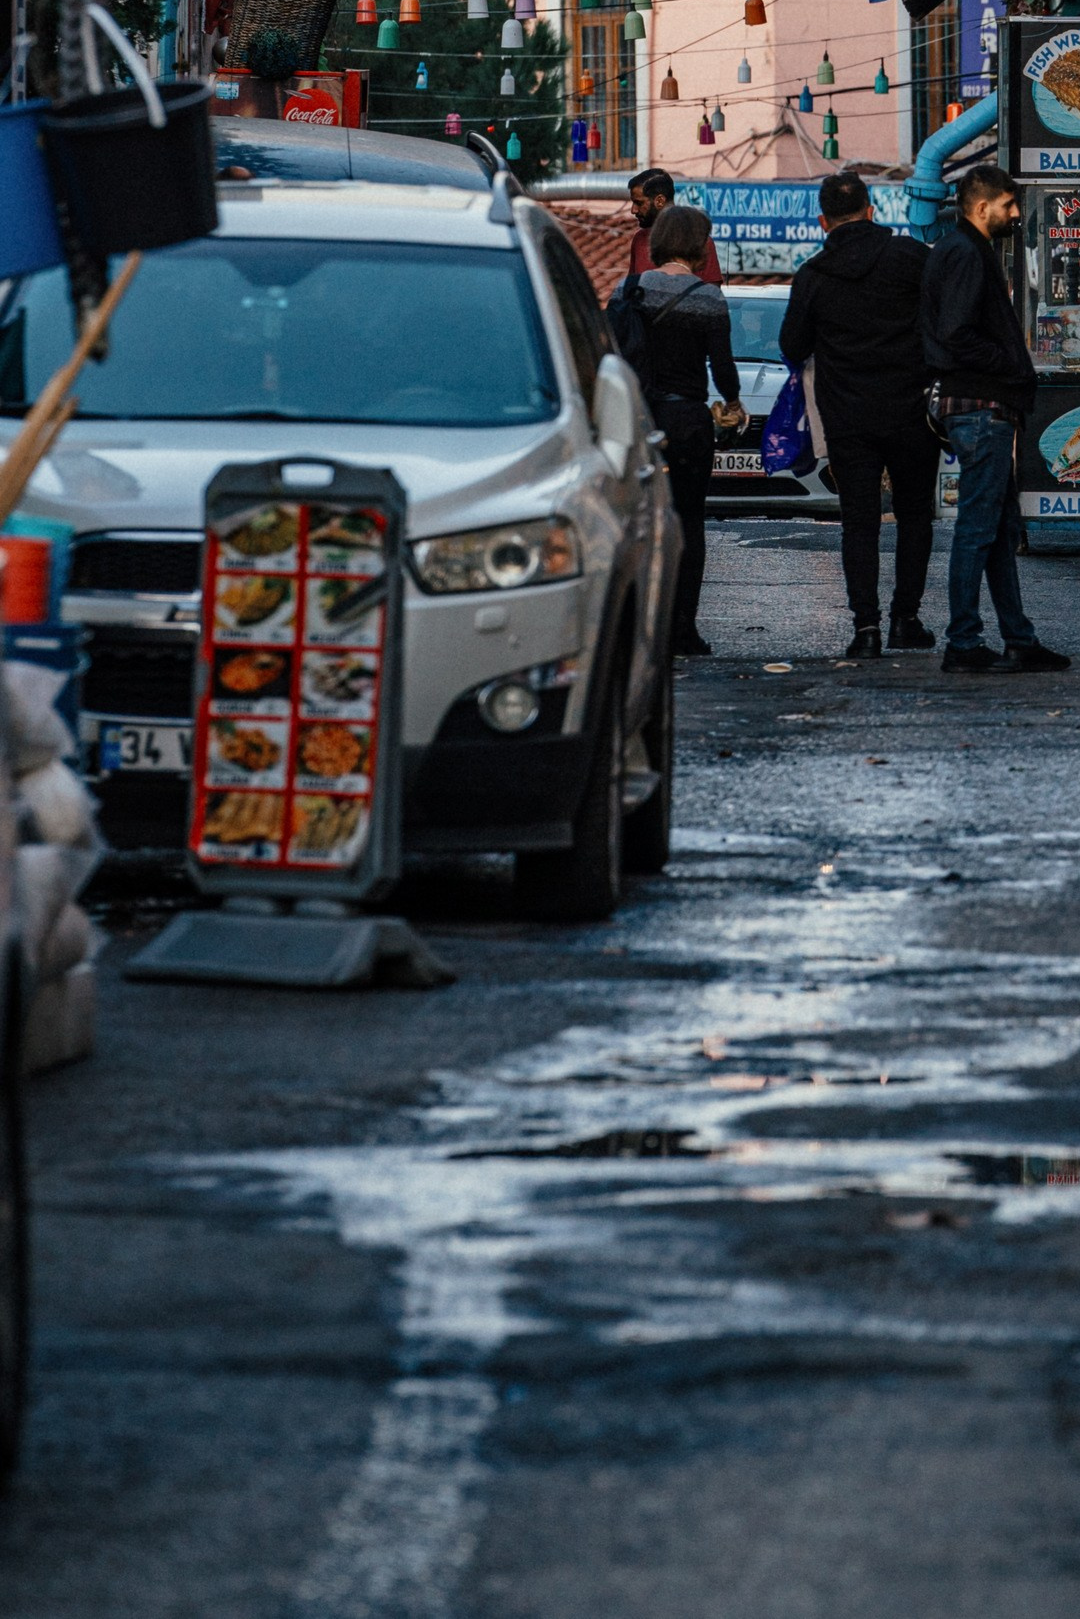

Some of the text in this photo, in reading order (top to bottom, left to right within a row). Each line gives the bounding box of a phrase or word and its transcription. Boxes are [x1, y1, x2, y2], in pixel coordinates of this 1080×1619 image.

[1027, 47, 1055, 78] FISH
[285, 107, 337, 124] Coca-Cola
[708, 188, 806, 218] YAKAMOZ
[711, 223, 731, 238] ED
[736, 224, 771, 238] FISH
[726, 455, 763, 470] 0349
[121, 730, 162, 764] 34
